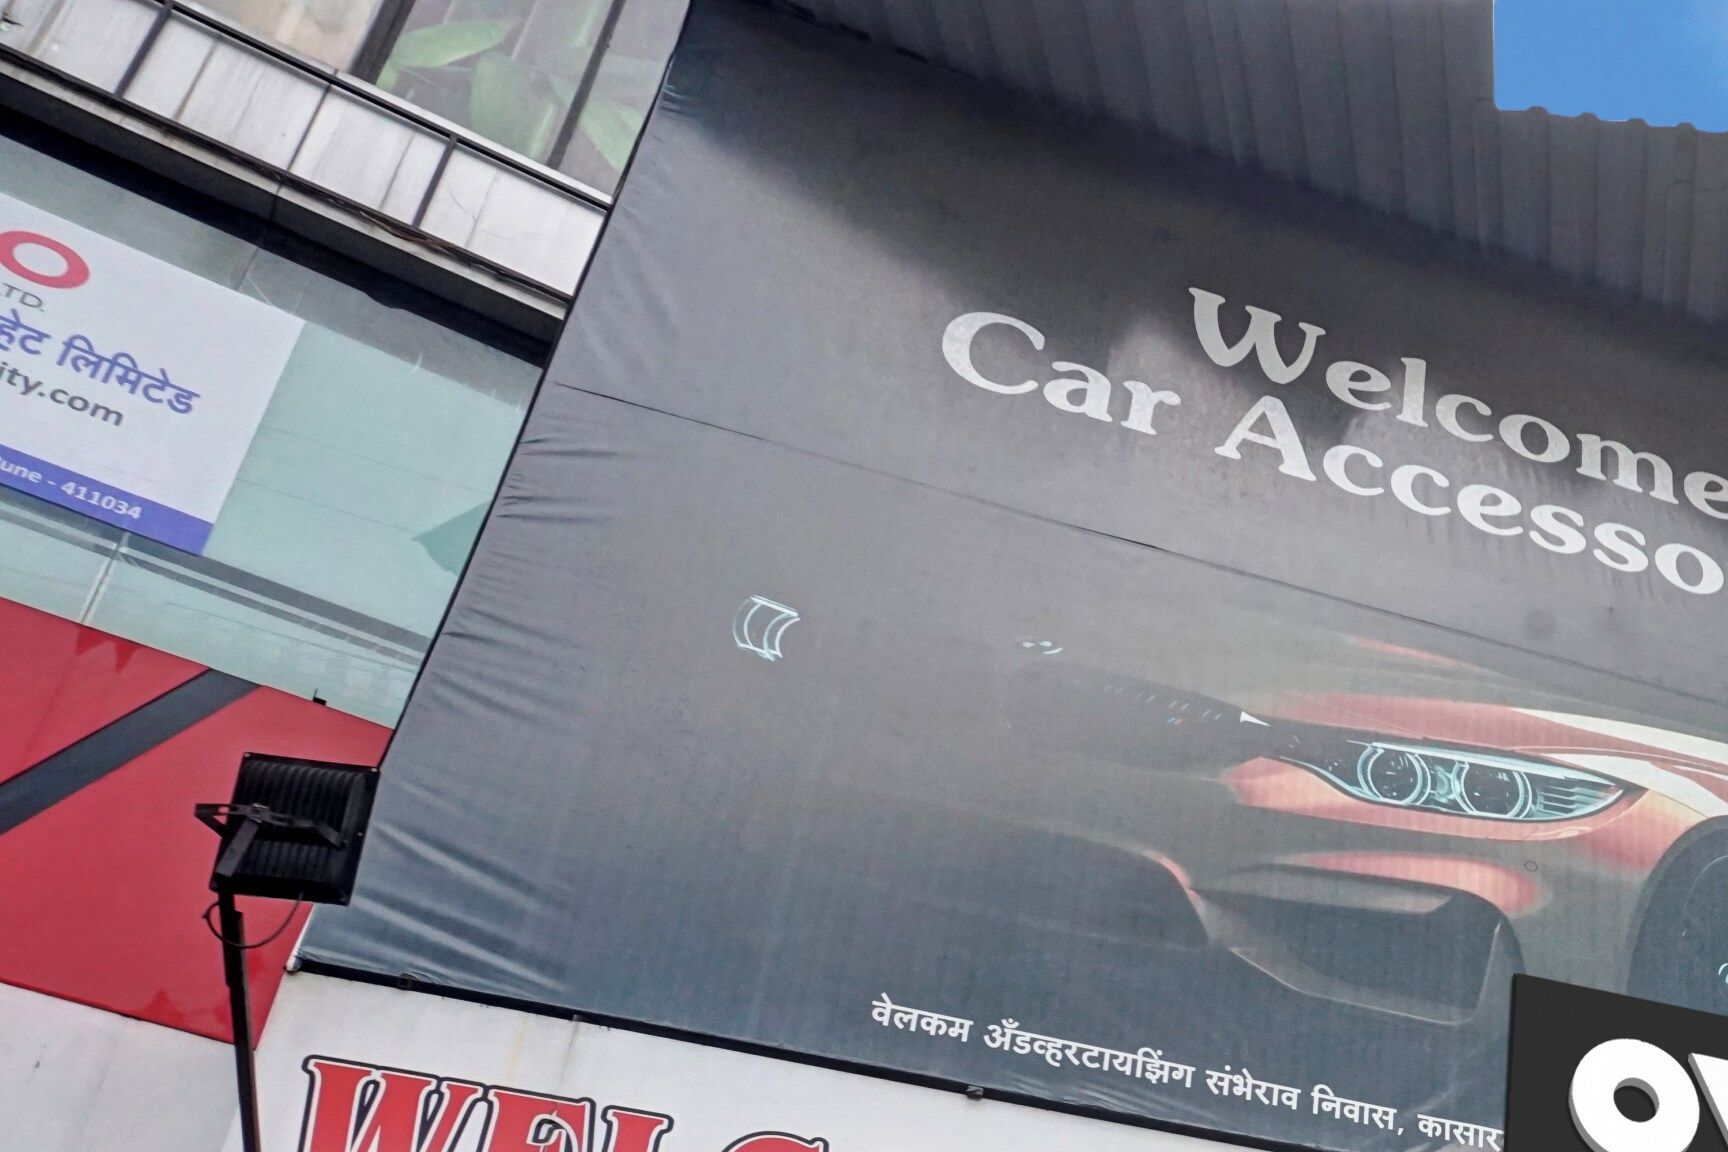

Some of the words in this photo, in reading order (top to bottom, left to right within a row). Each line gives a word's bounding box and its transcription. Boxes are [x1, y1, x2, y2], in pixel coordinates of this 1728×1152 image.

[0, 283, 45, 313] TD.
[56, 334, 201, 414] लिमिटेड
[941, 311, 1182, 435] Car
[0, 457, 43, 484] une
[60, 481, 143, 520] 411034
[871, 993, 973, 1043] वेलकम
[1206, 1068, 1302, 1110] संभेराव
[1311, 1084, 1404, 1136] निवास,
[1417, 1113, 1505, 1152] कासार
